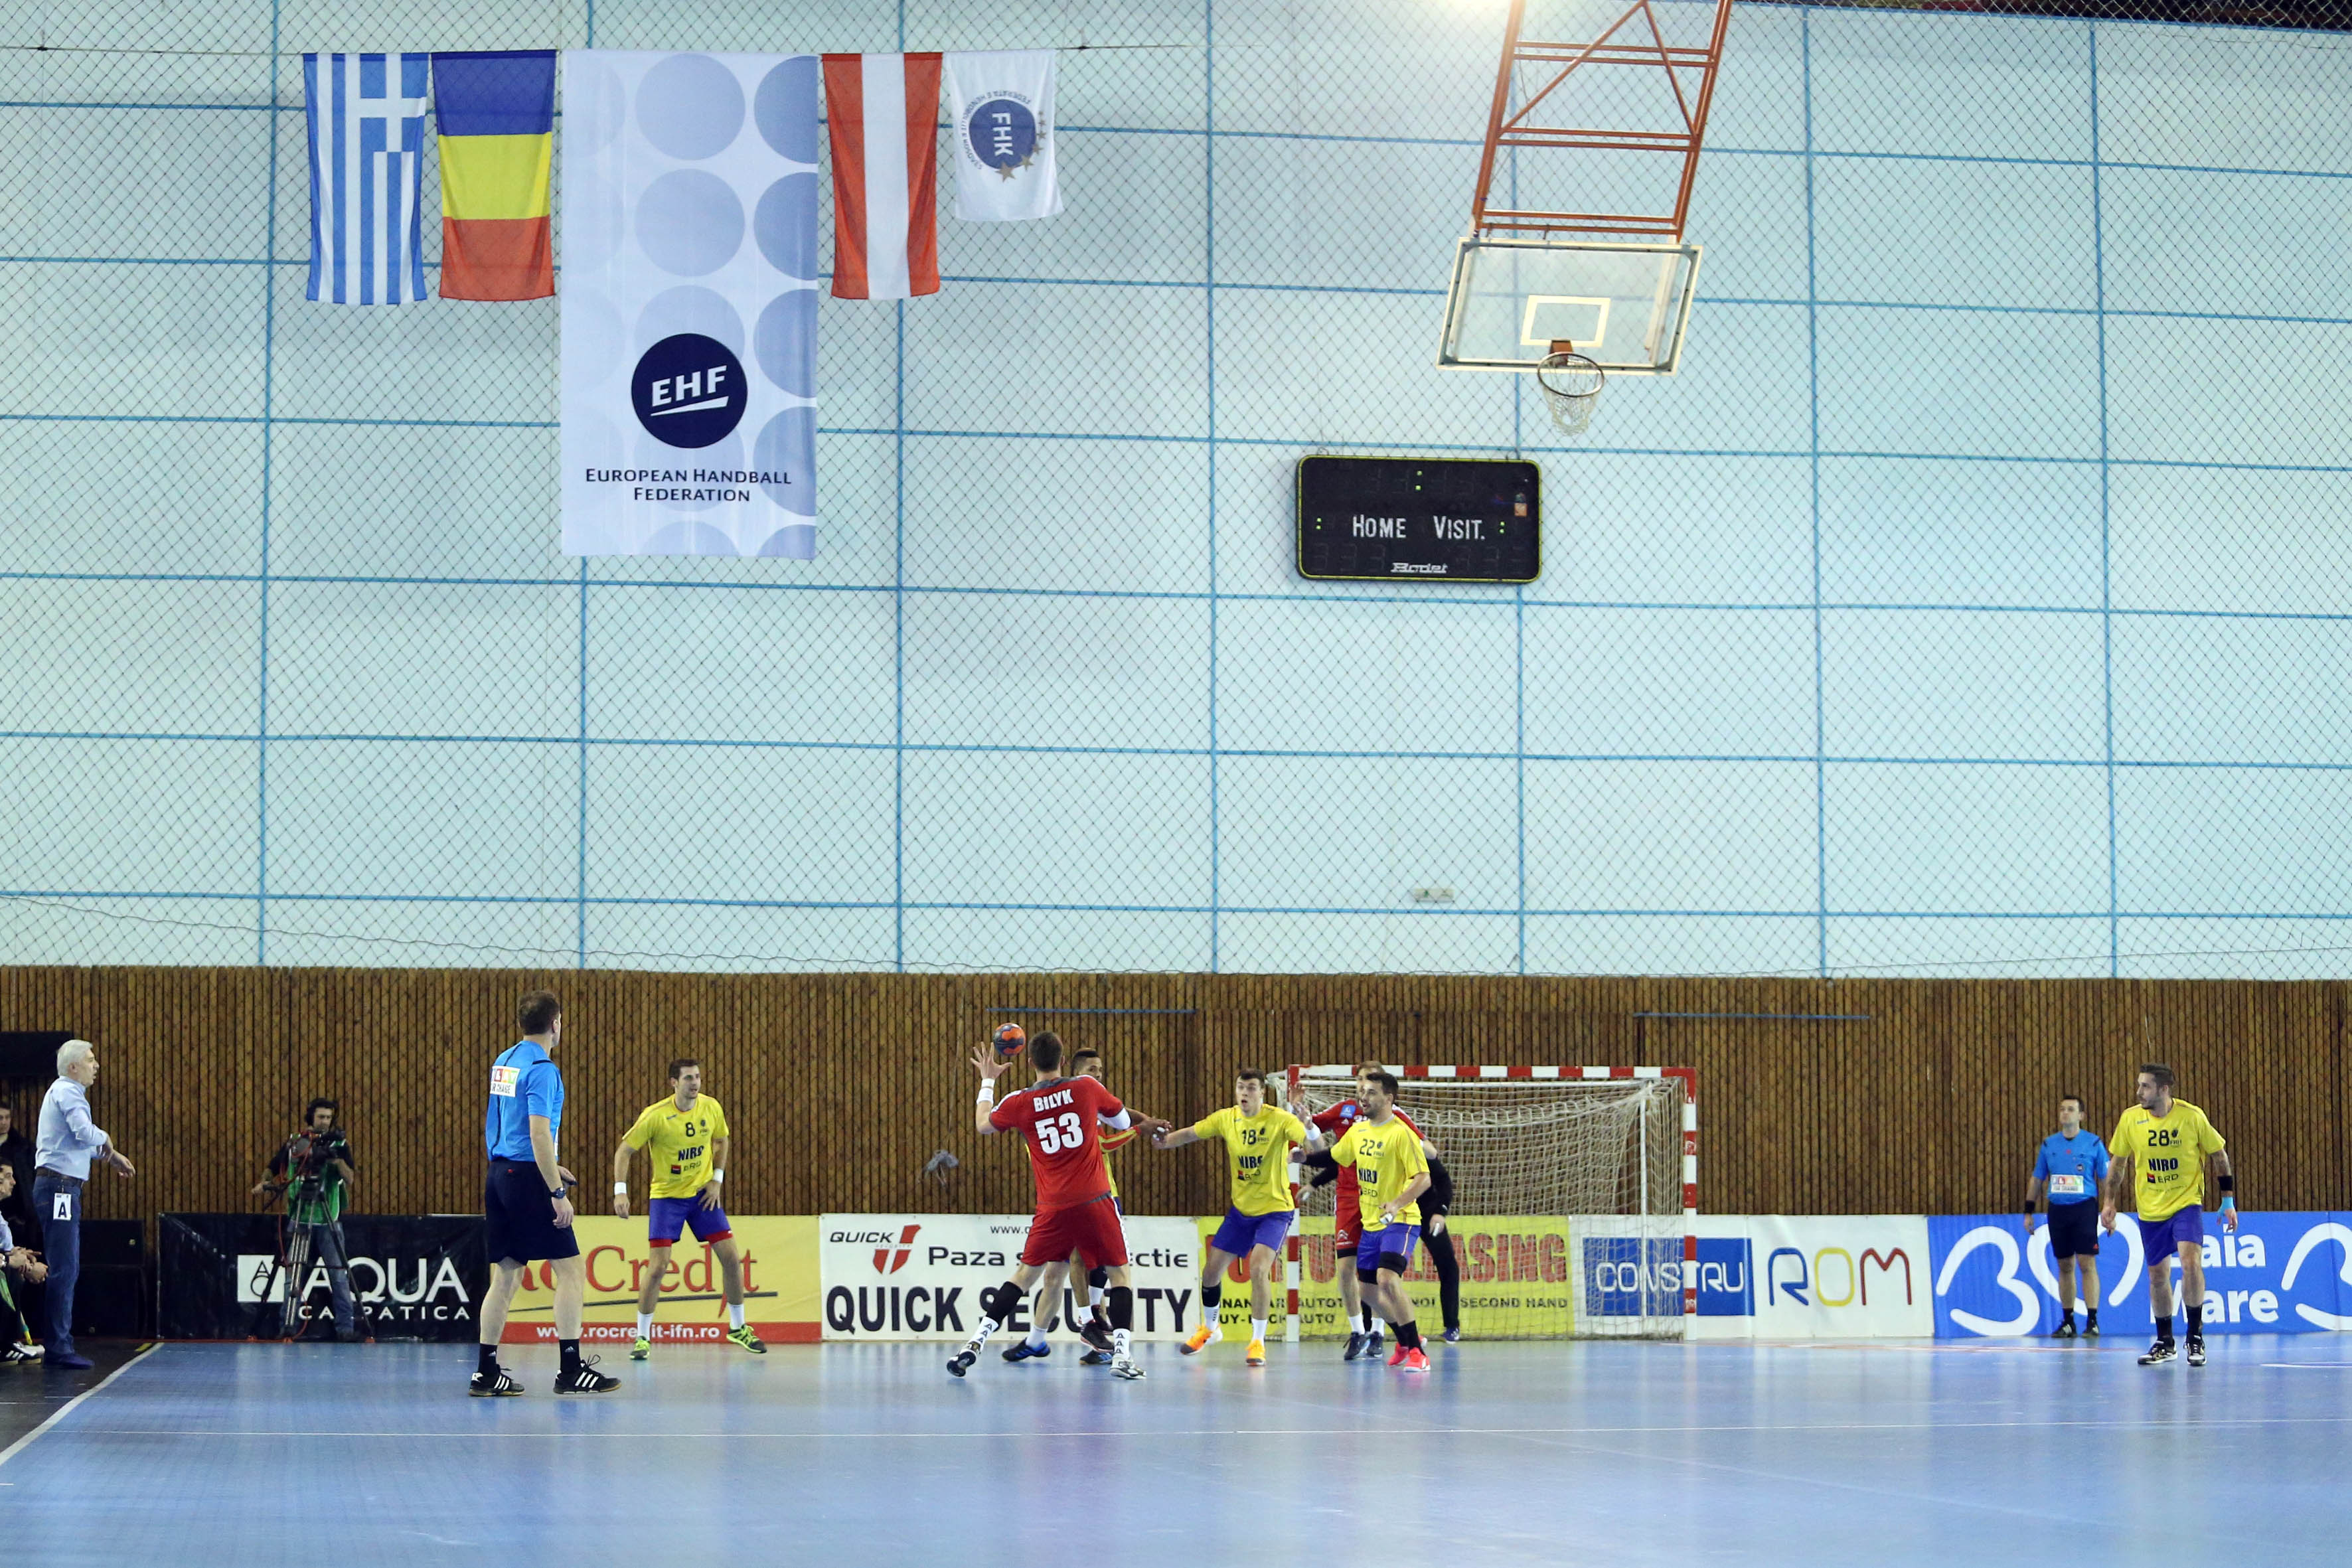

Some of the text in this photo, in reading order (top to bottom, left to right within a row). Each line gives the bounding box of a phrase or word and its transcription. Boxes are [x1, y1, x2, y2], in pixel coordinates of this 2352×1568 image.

[992, 113, 1014, 157] FHK
[652, 365, 727, 407] EHF
[586, 469, 792, 485] EUROPEAN HANDBALL
[634, 487, 750, 501] FEDERATION
[1033, 1089, 1074, 1112] BILYK
[686, 1122, 696, 1137] 8
[1035, 1112, 1083, 1154] 53
[1242, 1129, 1257, 1145] 18
[2148, 1130, 2169, 1146] 28
[1360, 1138, 1375, 1156] 22
[2148, 1158, 2179, 1172] NIRO
[58, 1202, 67, 1217] A
[830, 1231, 895, 1243] QUICK
[2169, 1223, 2266, 1268] aia
[929, 1246, 1005, 1266] Paza
[300, 1256, 469, 1304] AQUA
[826, 1285, 965, 1335] QUICK
[1460, 1298, 1568, 1308] SECOND HAND
[299, 1305, 471, 1320] CAPATICA
